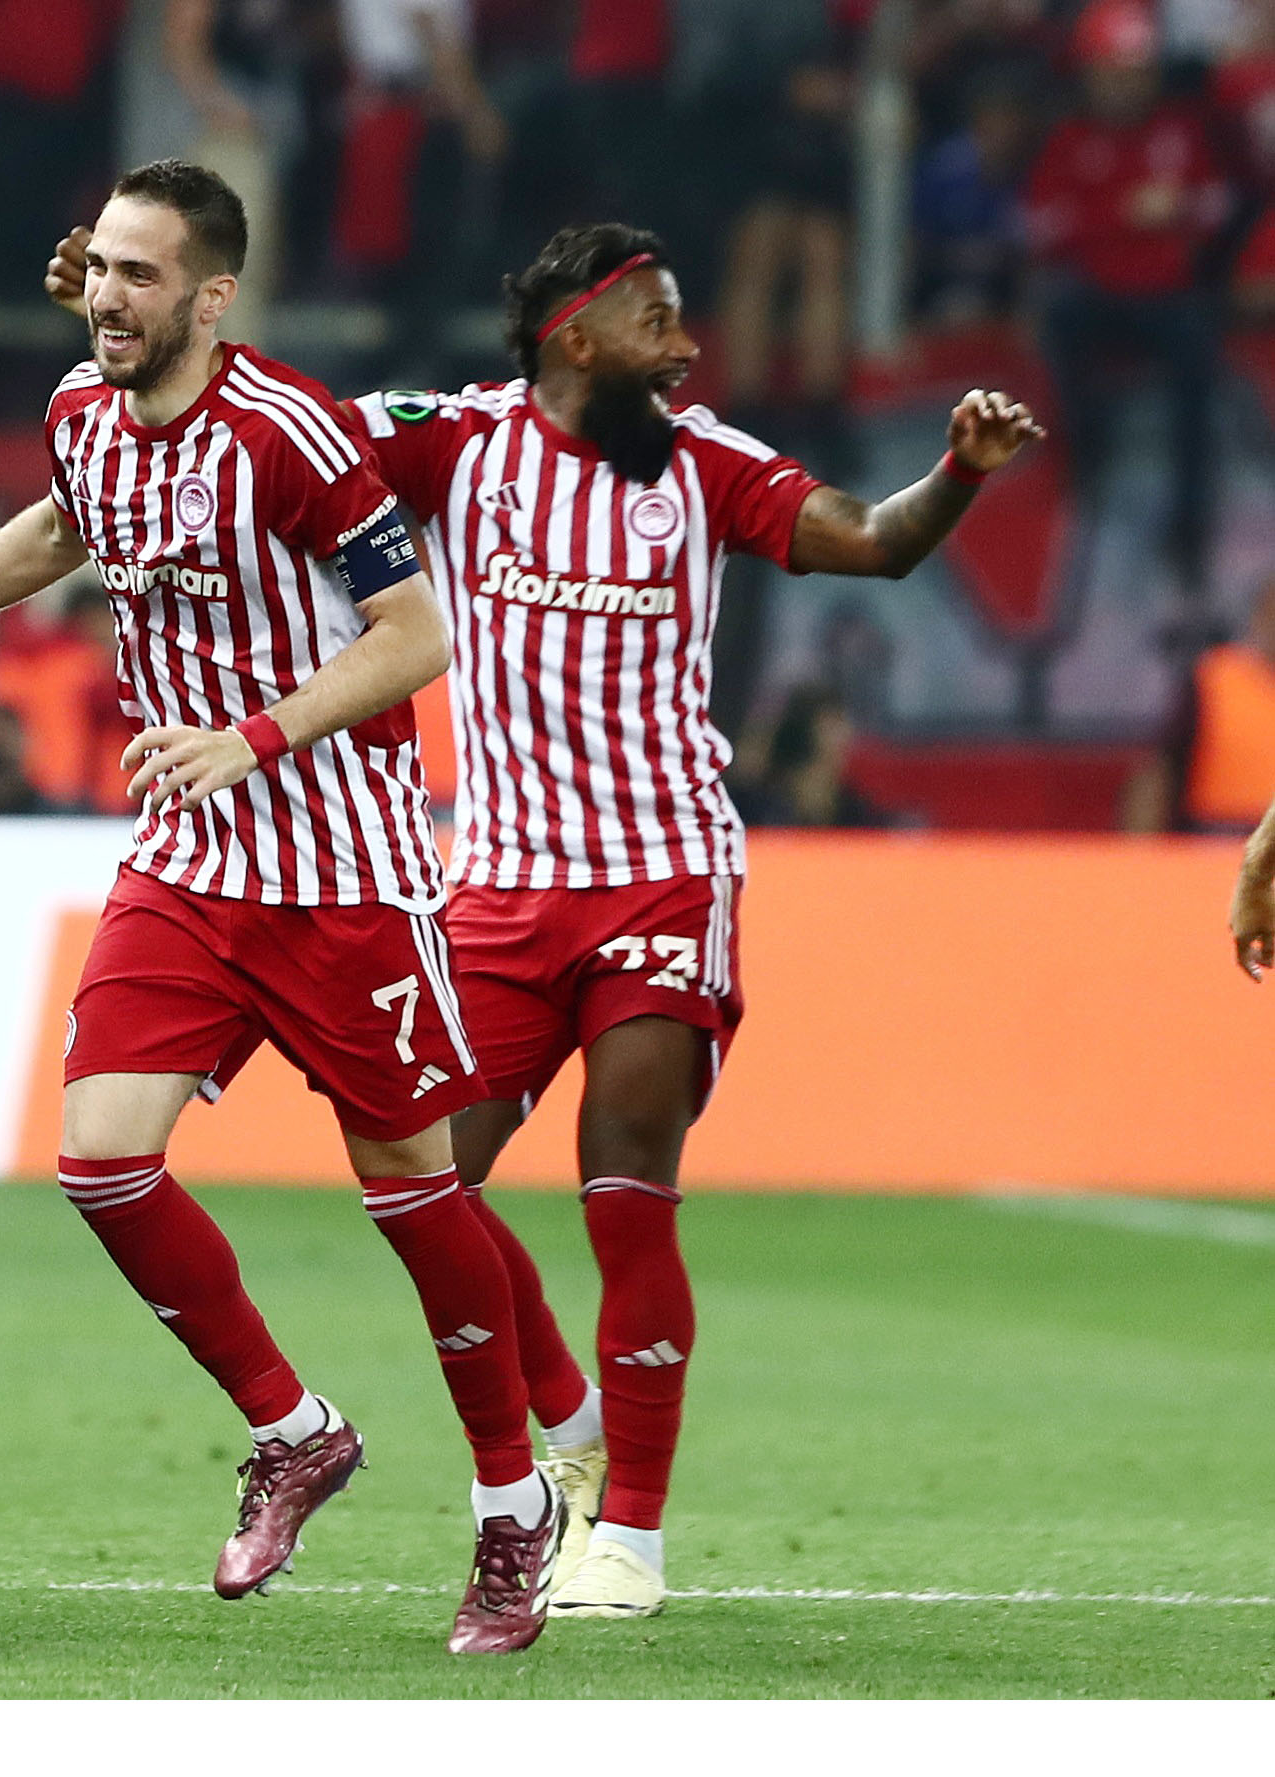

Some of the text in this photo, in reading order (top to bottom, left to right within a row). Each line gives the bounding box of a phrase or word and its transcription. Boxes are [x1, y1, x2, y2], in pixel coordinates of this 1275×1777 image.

[86, 548, 229, 598] toiiman
[478, 553, 677, 616] Stoiximan
[370, 974, 421, 1065] 7
